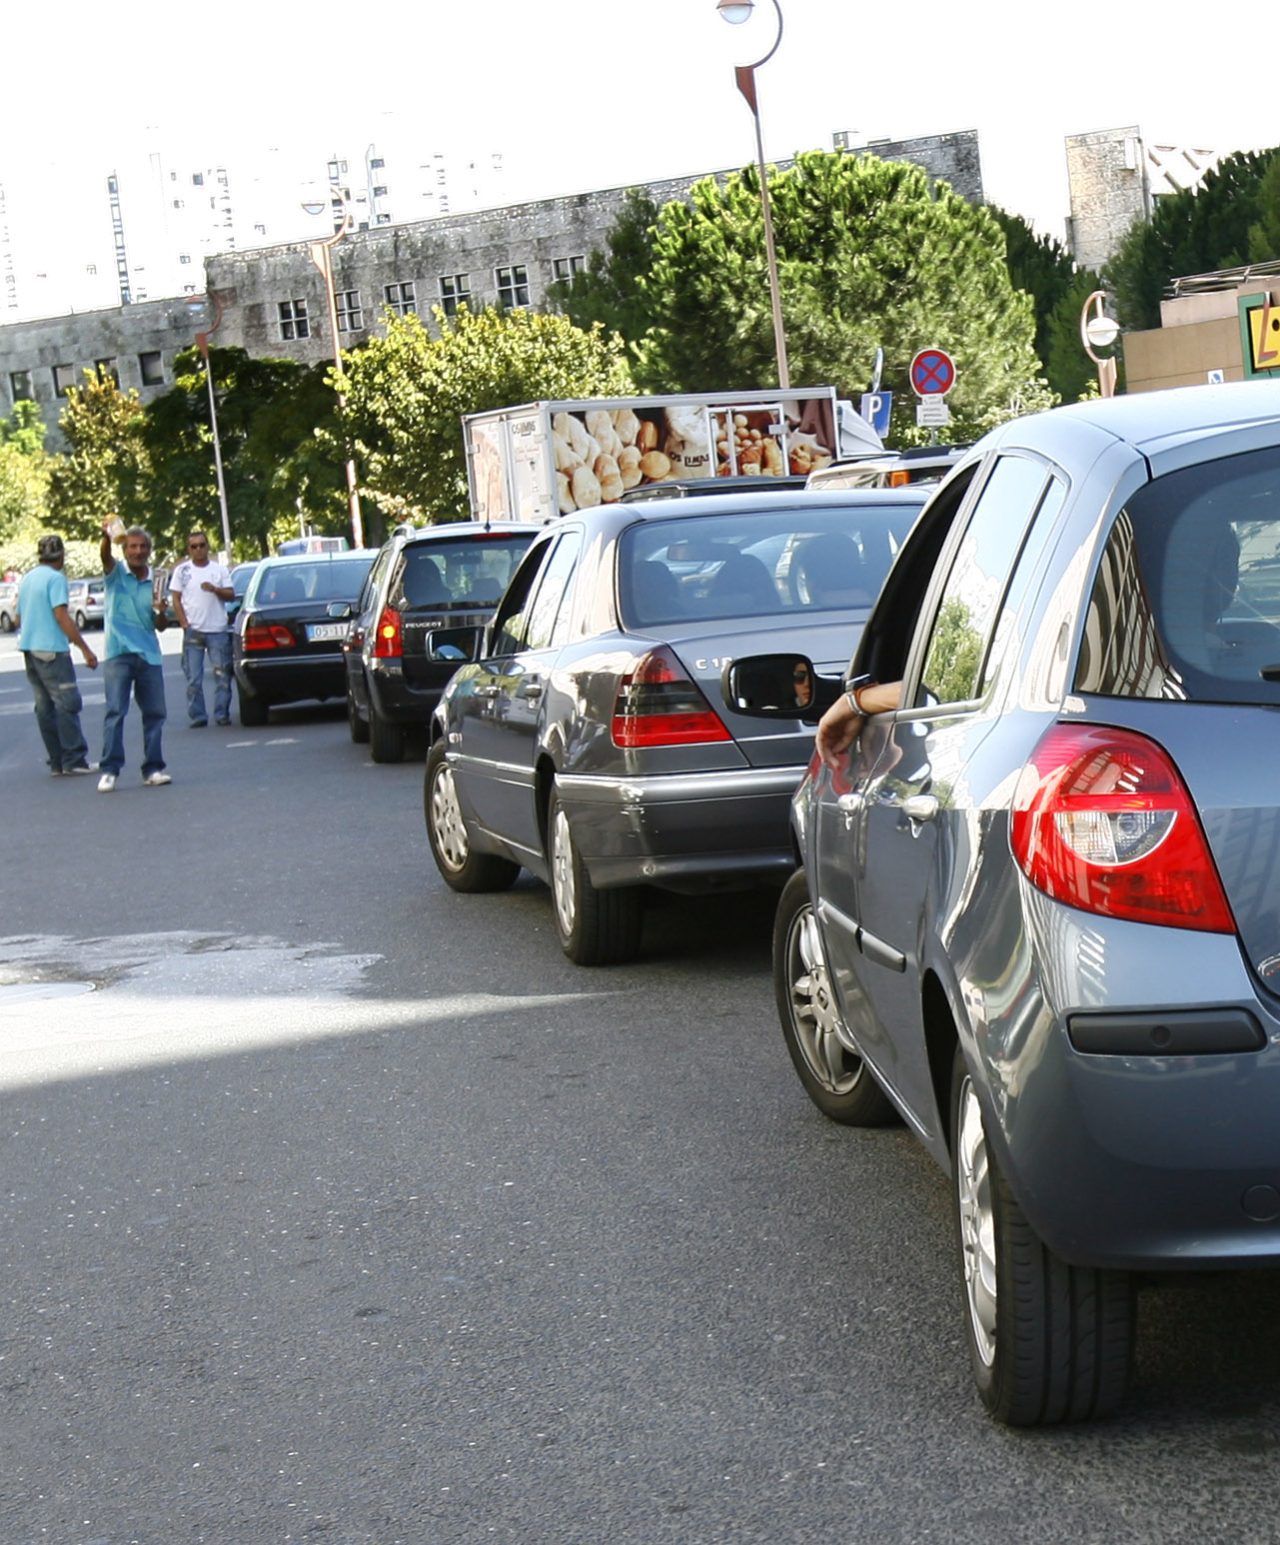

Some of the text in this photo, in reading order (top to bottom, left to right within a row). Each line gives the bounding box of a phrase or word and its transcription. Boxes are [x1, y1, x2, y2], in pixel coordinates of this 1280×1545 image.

[868, 395, 882, 424] P
[405, 621, 442, 629] PEUGEOT
[695, 658, 707, 670] C
